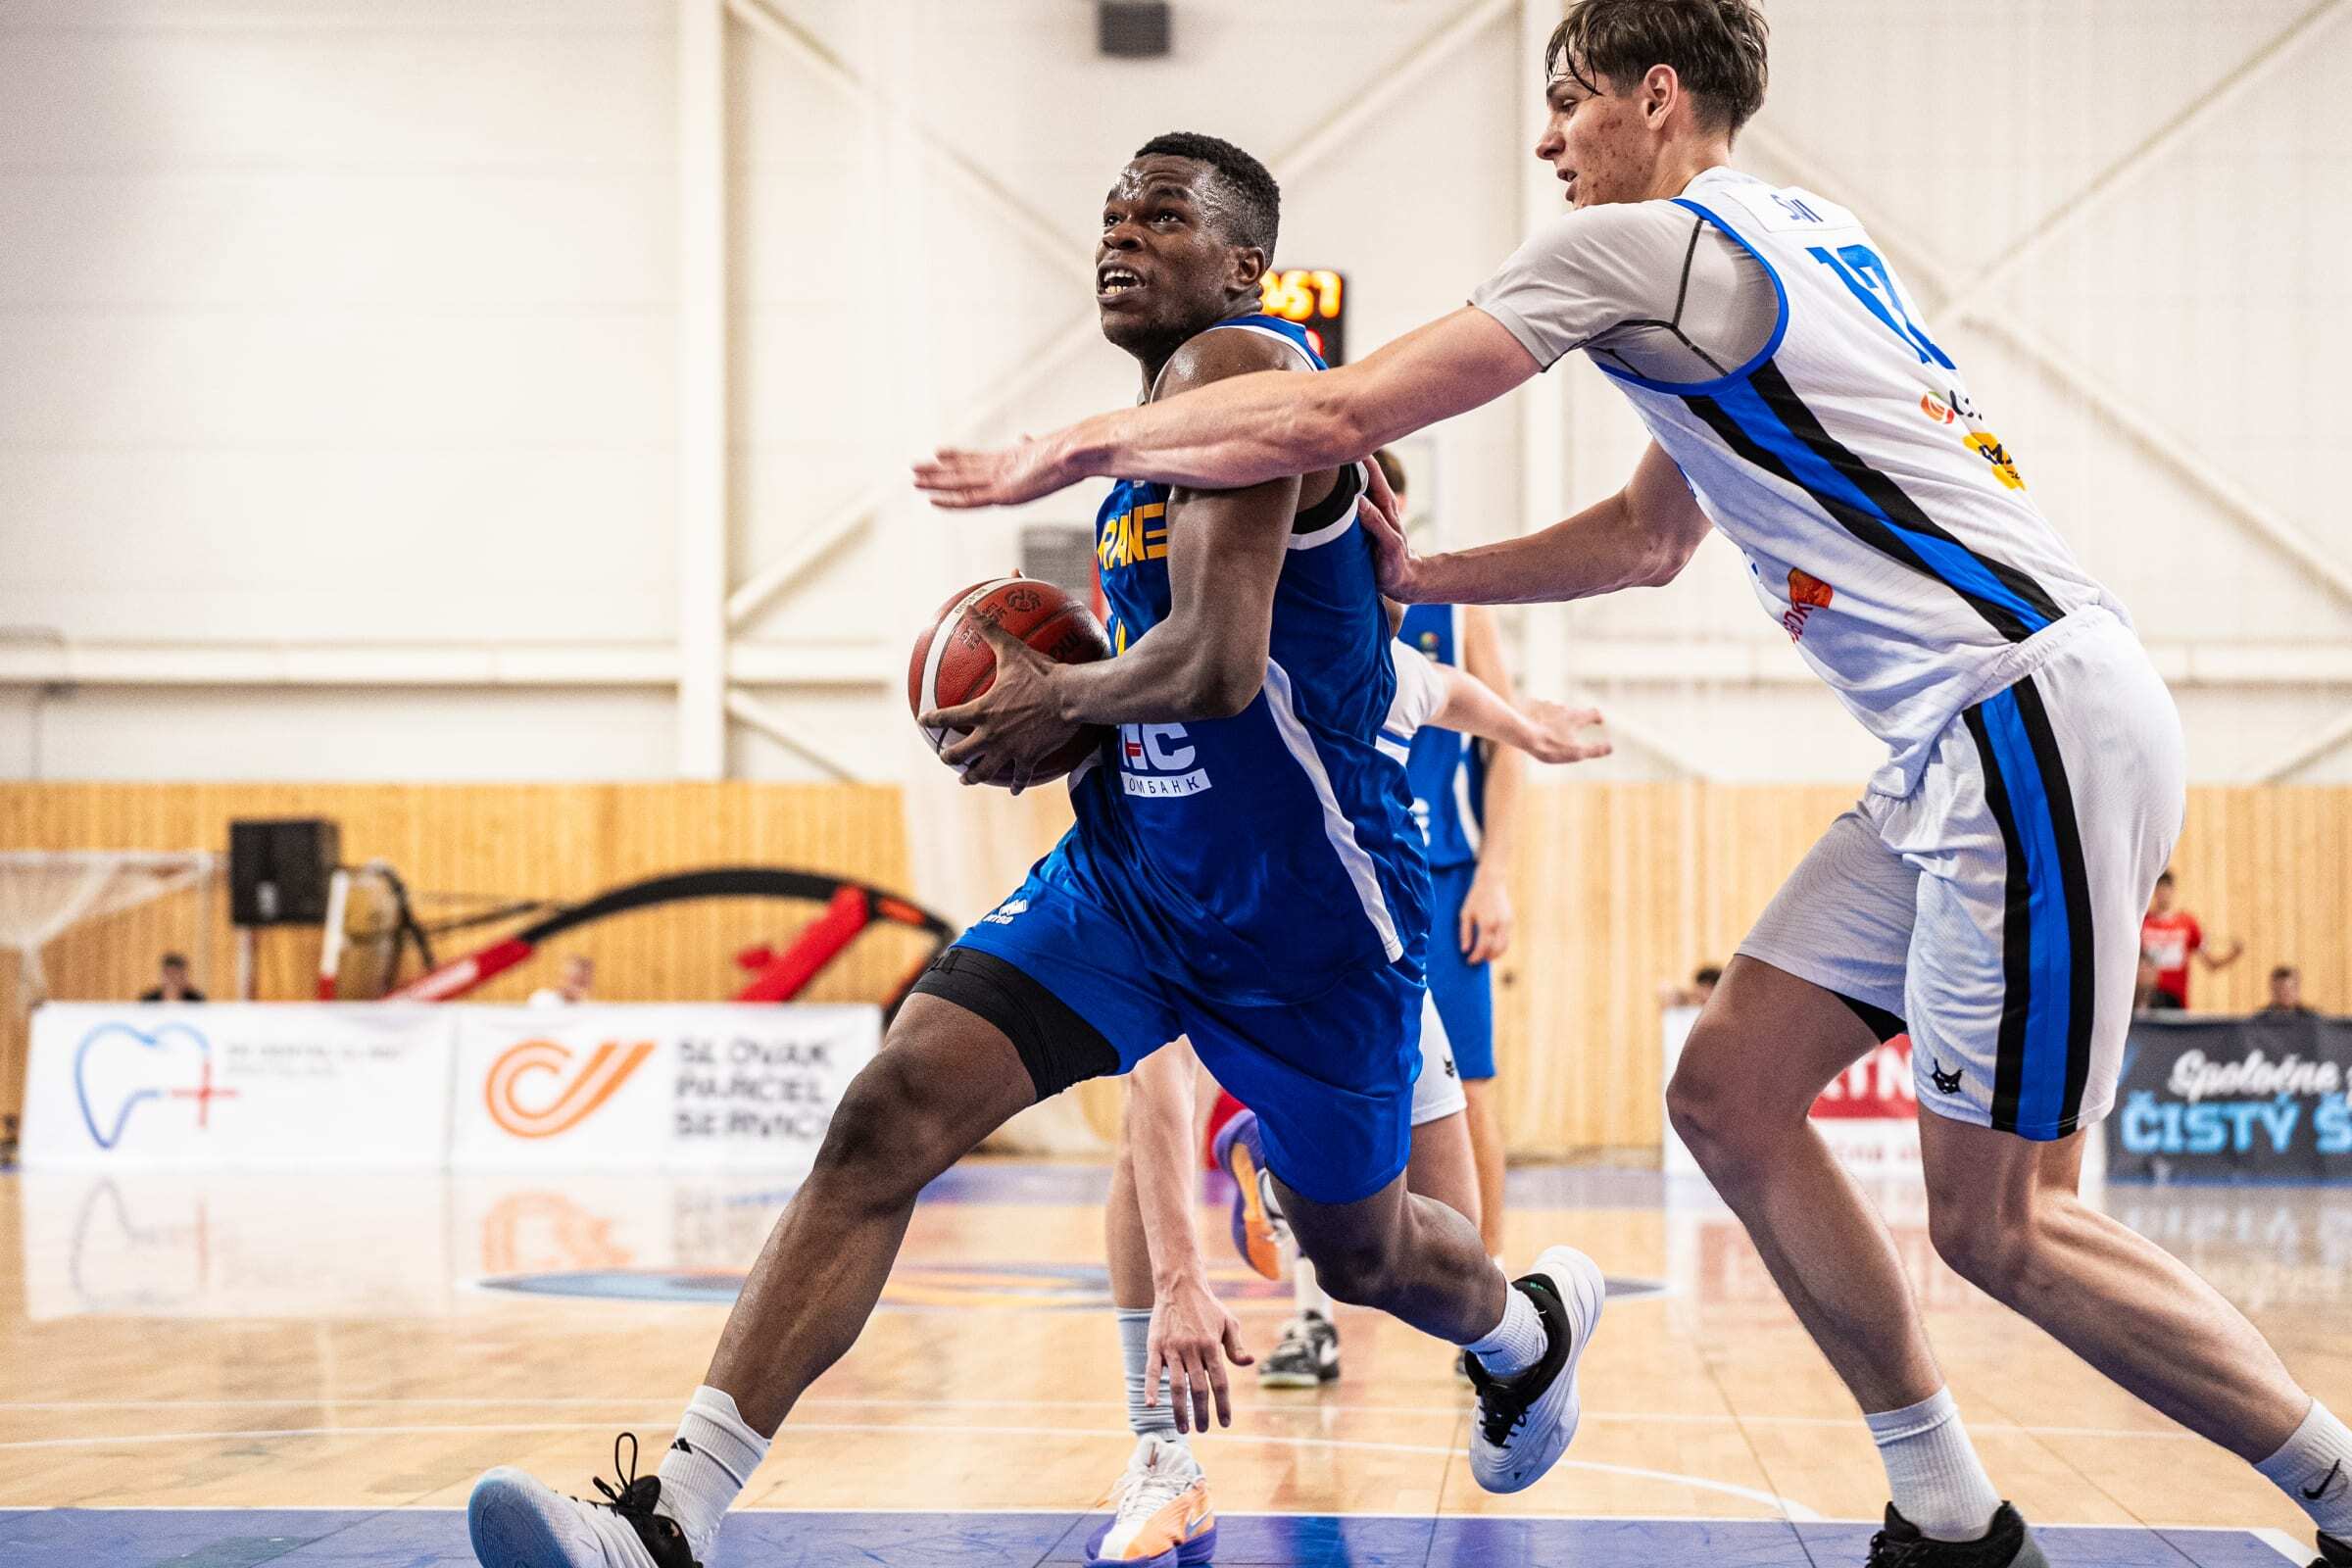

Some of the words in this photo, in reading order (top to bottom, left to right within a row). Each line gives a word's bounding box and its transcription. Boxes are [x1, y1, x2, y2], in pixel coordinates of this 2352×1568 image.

[677, 1037, 833, 1065] SLOVAK
[675, 1074, 825, 1102] PARCEL
[2121, 1090, 2301, 1154] ČISTÝ
